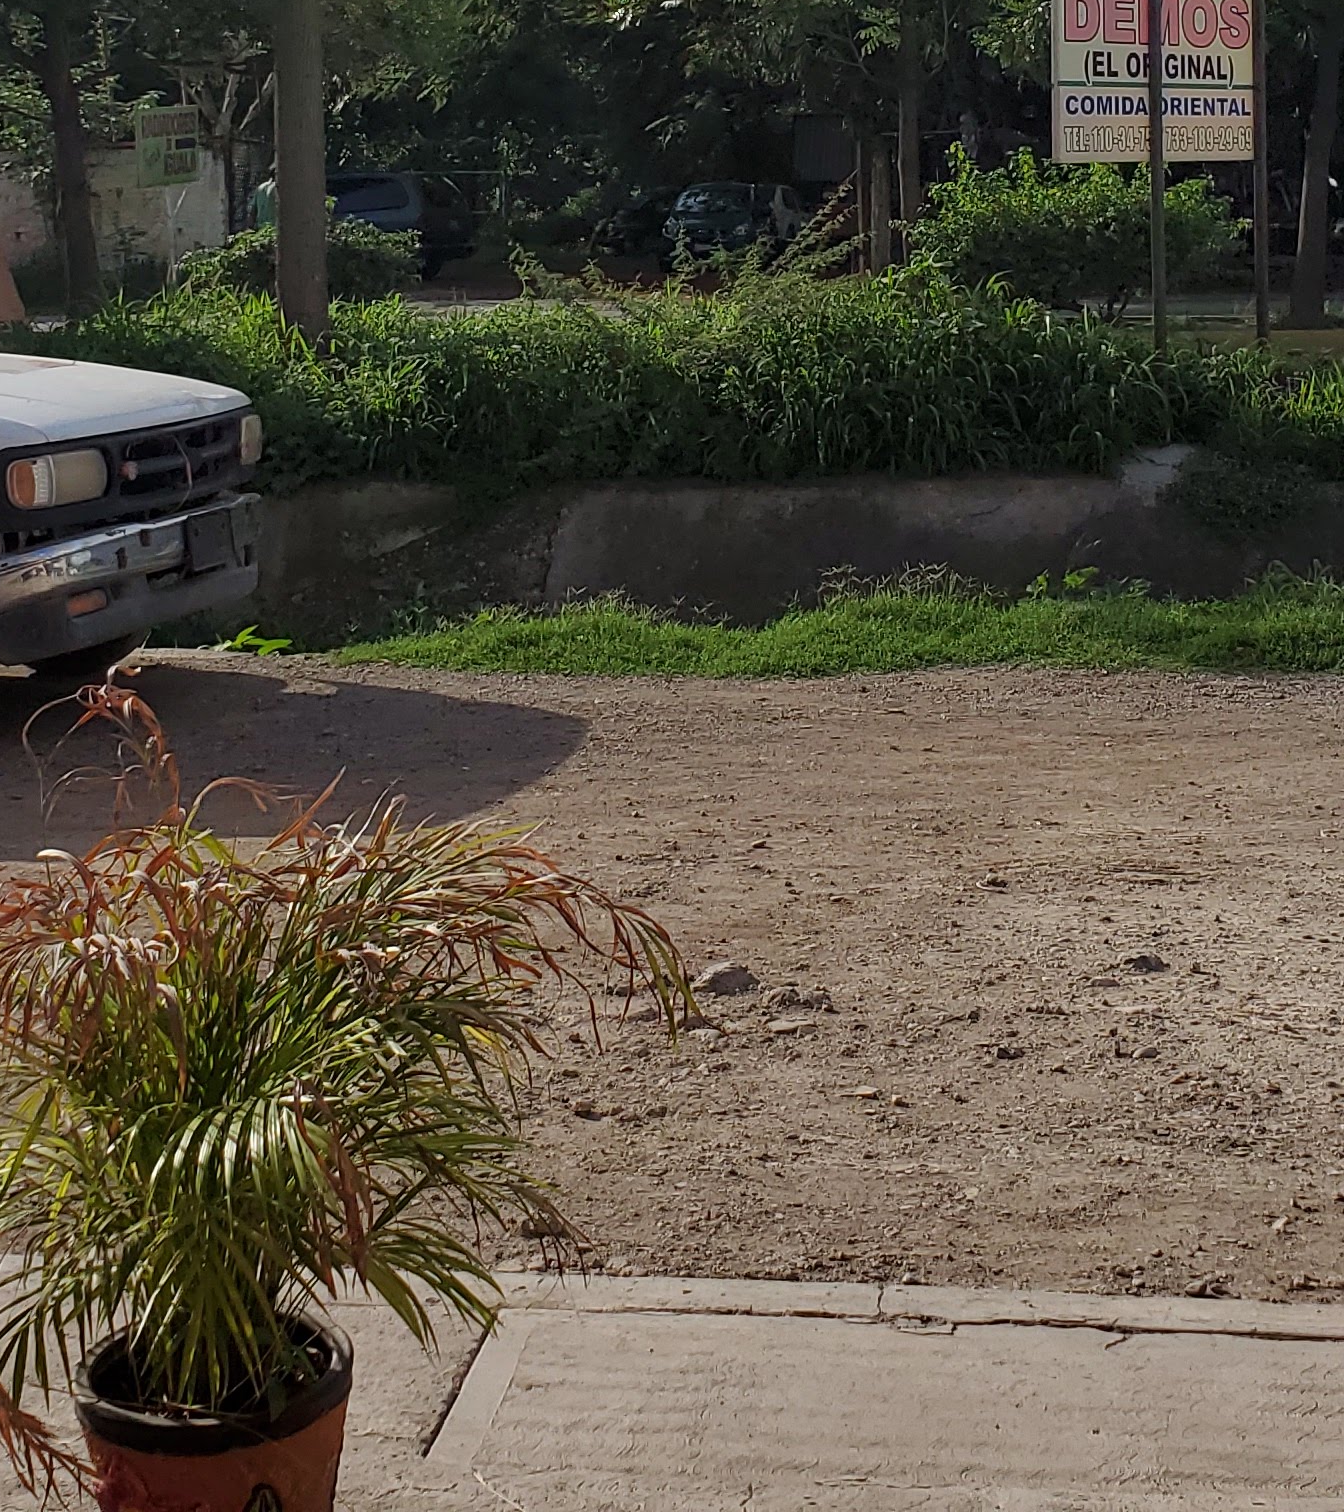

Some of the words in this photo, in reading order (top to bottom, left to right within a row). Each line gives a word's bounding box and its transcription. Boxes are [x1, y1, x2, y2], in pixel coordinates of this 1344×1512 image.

[1126, 53, 1233, 88] OGINAL)
[1065, 95, 1149, 115] COMIDA
[1165, 126, 1253, 152] 733-189-29-69
